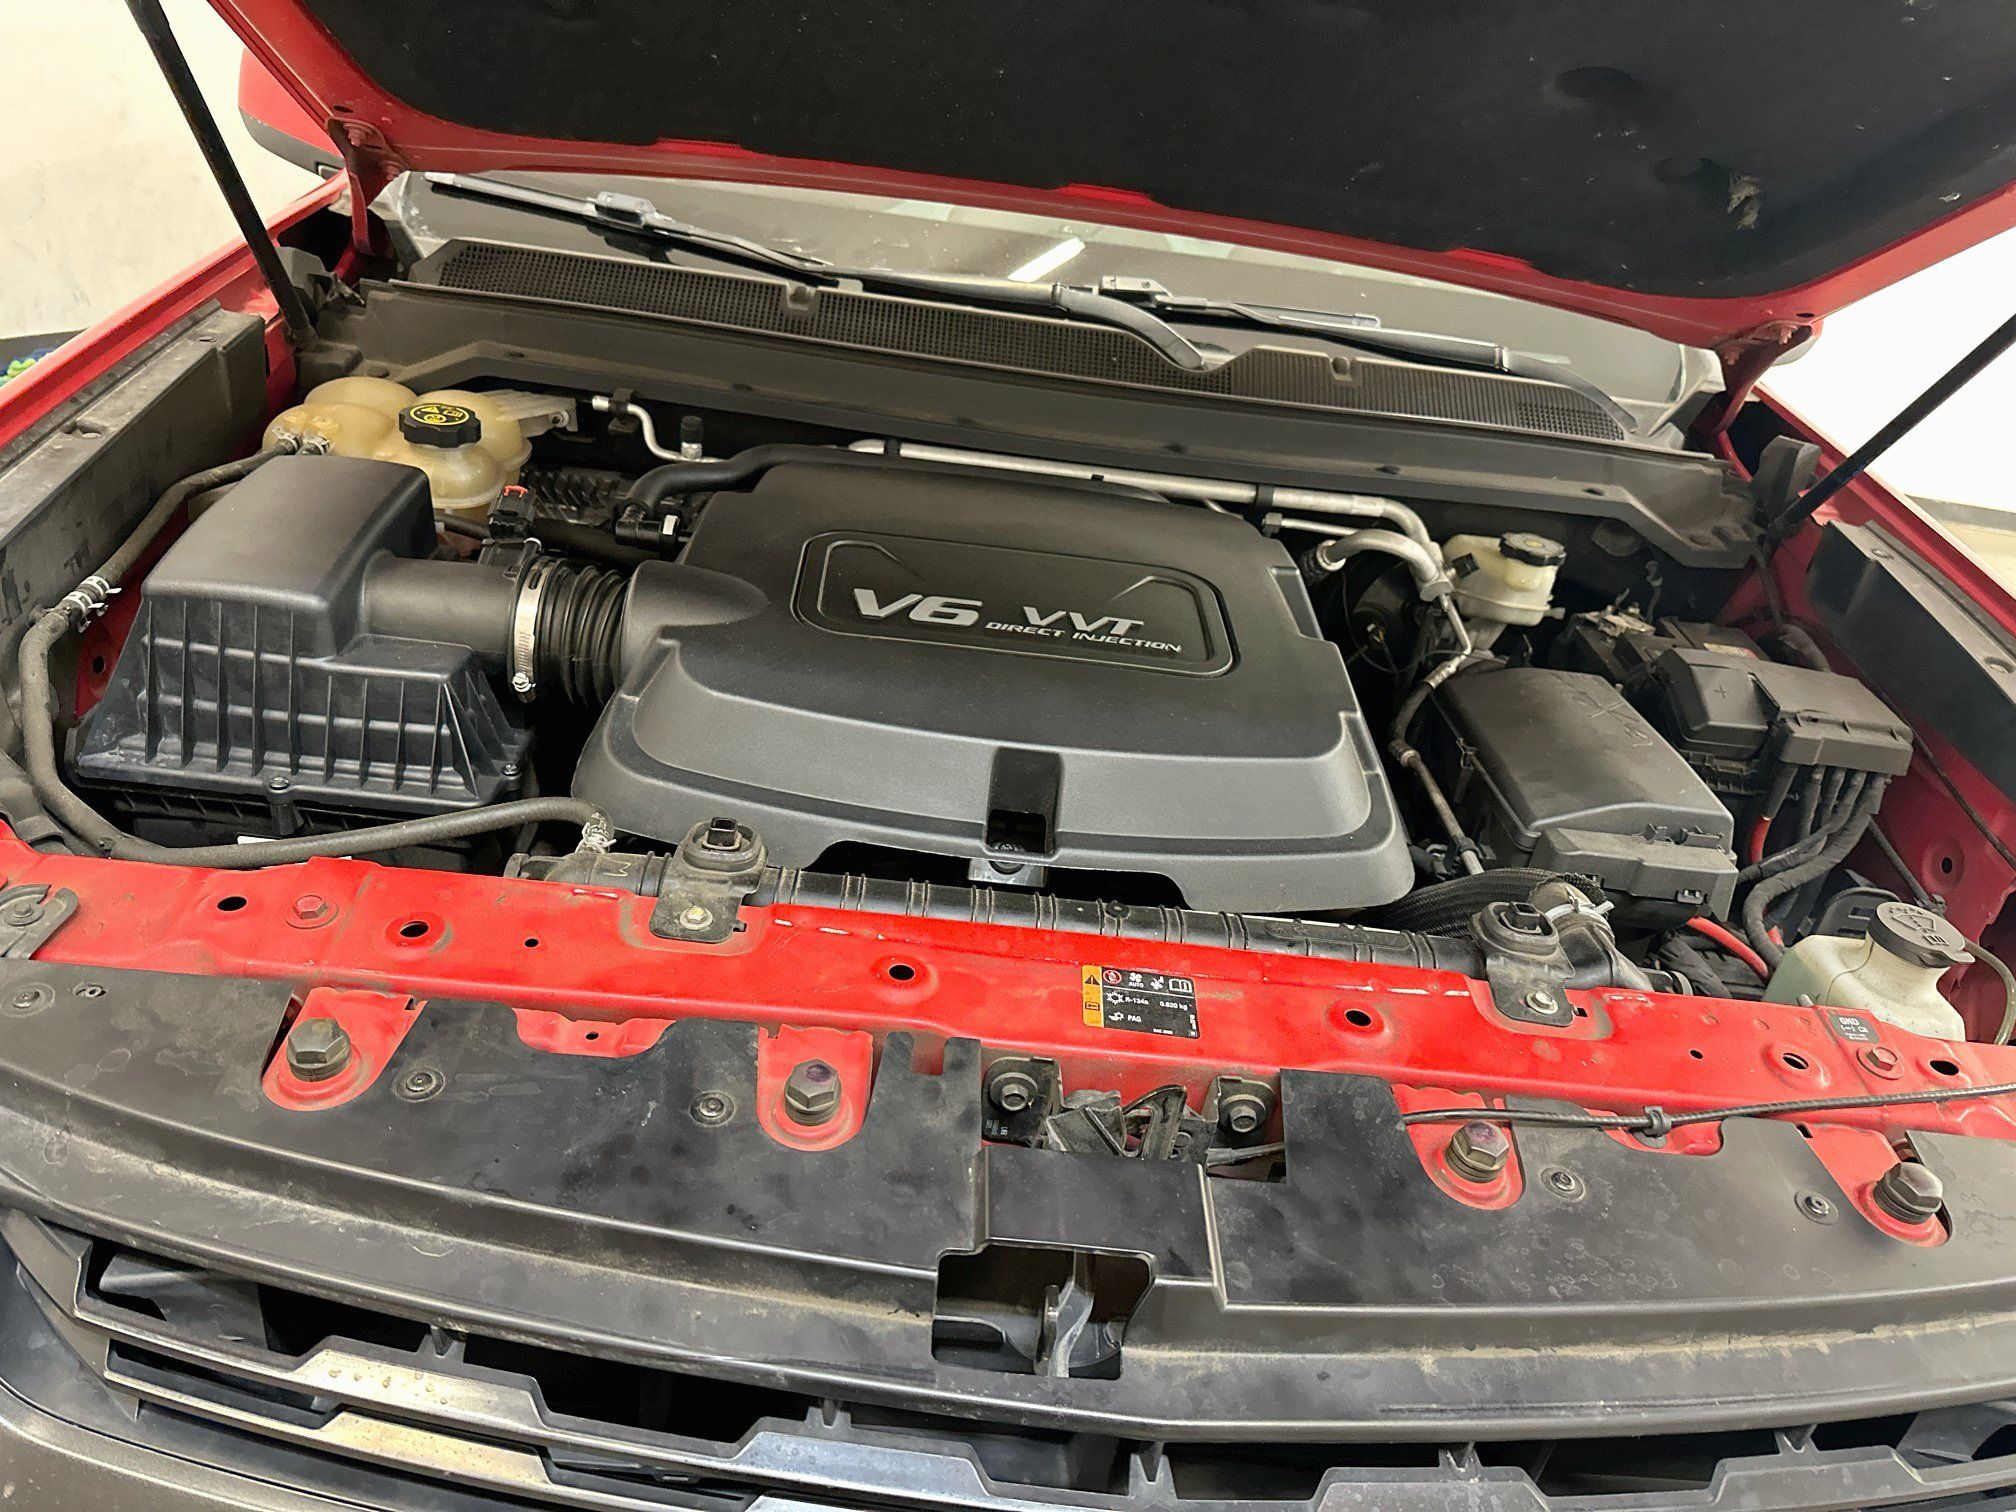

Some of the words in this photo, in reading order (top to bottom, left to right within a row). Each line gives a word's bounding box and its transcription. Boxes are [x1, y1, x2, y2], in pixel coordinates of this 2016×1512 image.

[853, 588, 983, 627] V6
[1022, 606, 1144, 635] VVT
[985, 621, 1066, 638] DIRECT
[1072, 631, 1183, 653] INJECTION
[1125, 996, 1149, 1005] R-134a
[1179, 1003, 1188, 1011] kg
[1127, 1015, 1142, 1023] PAG
[1839, 1017, 1860, 1026] GND
